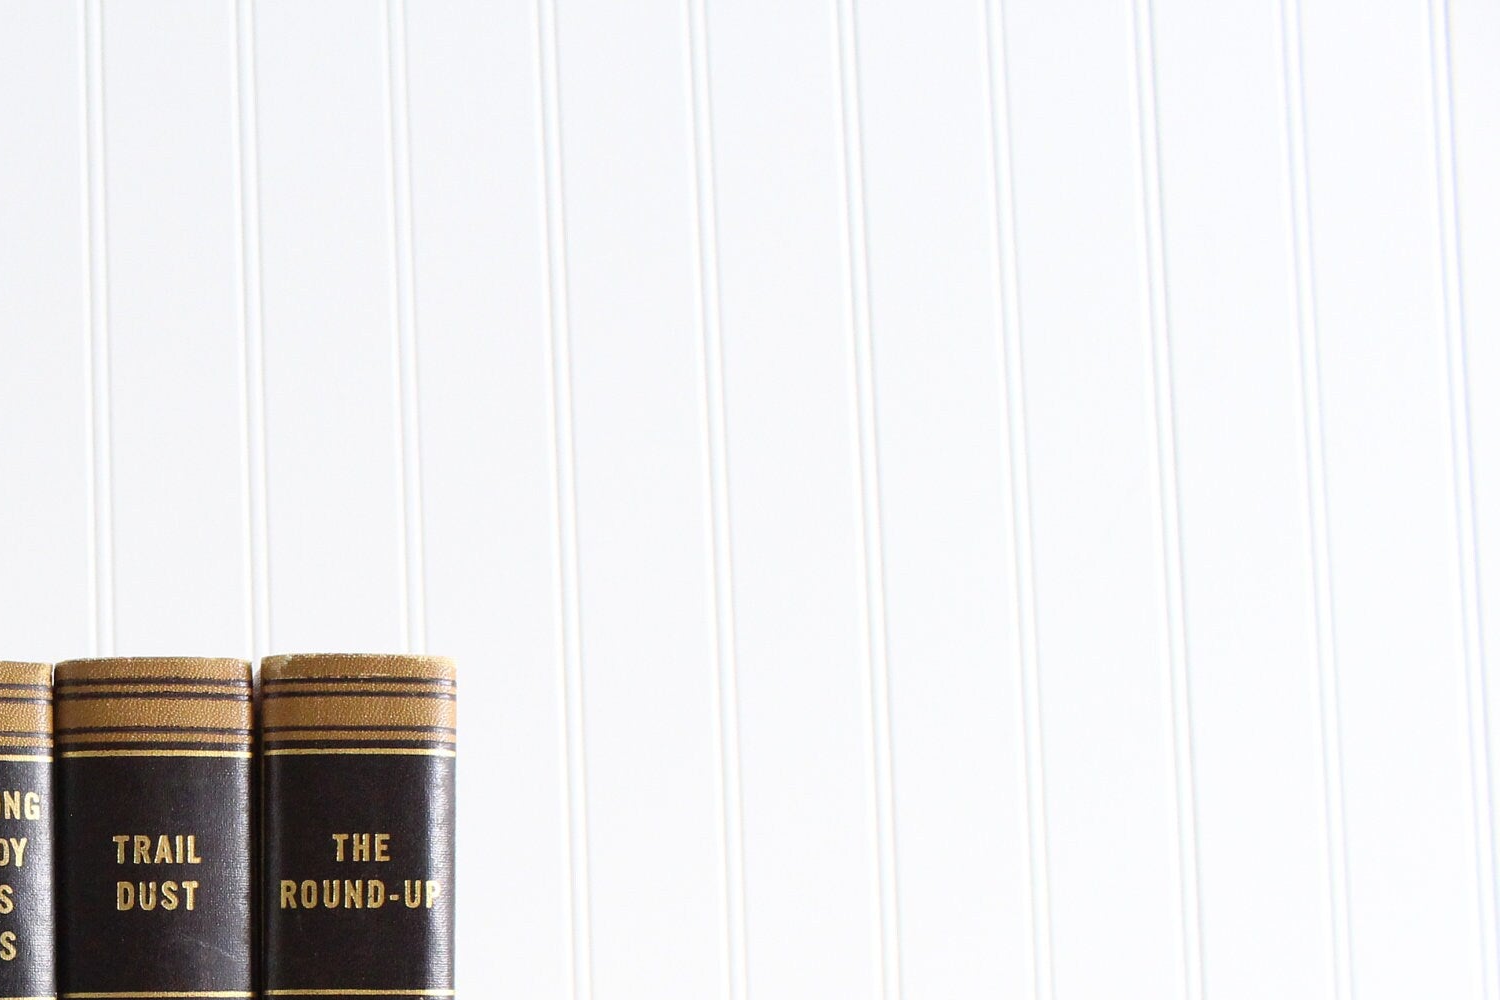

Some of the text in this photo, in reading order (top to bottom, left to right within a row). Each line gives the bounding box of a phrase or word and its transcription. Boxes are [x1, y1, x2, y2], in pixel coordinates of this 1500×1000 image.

[112, 834, 202, 865] TRAIL
[332, 833, 391, 862] THE
[116, 880, 198, 911] DUST
[280, 879, 441, 910] ROUND-UP
